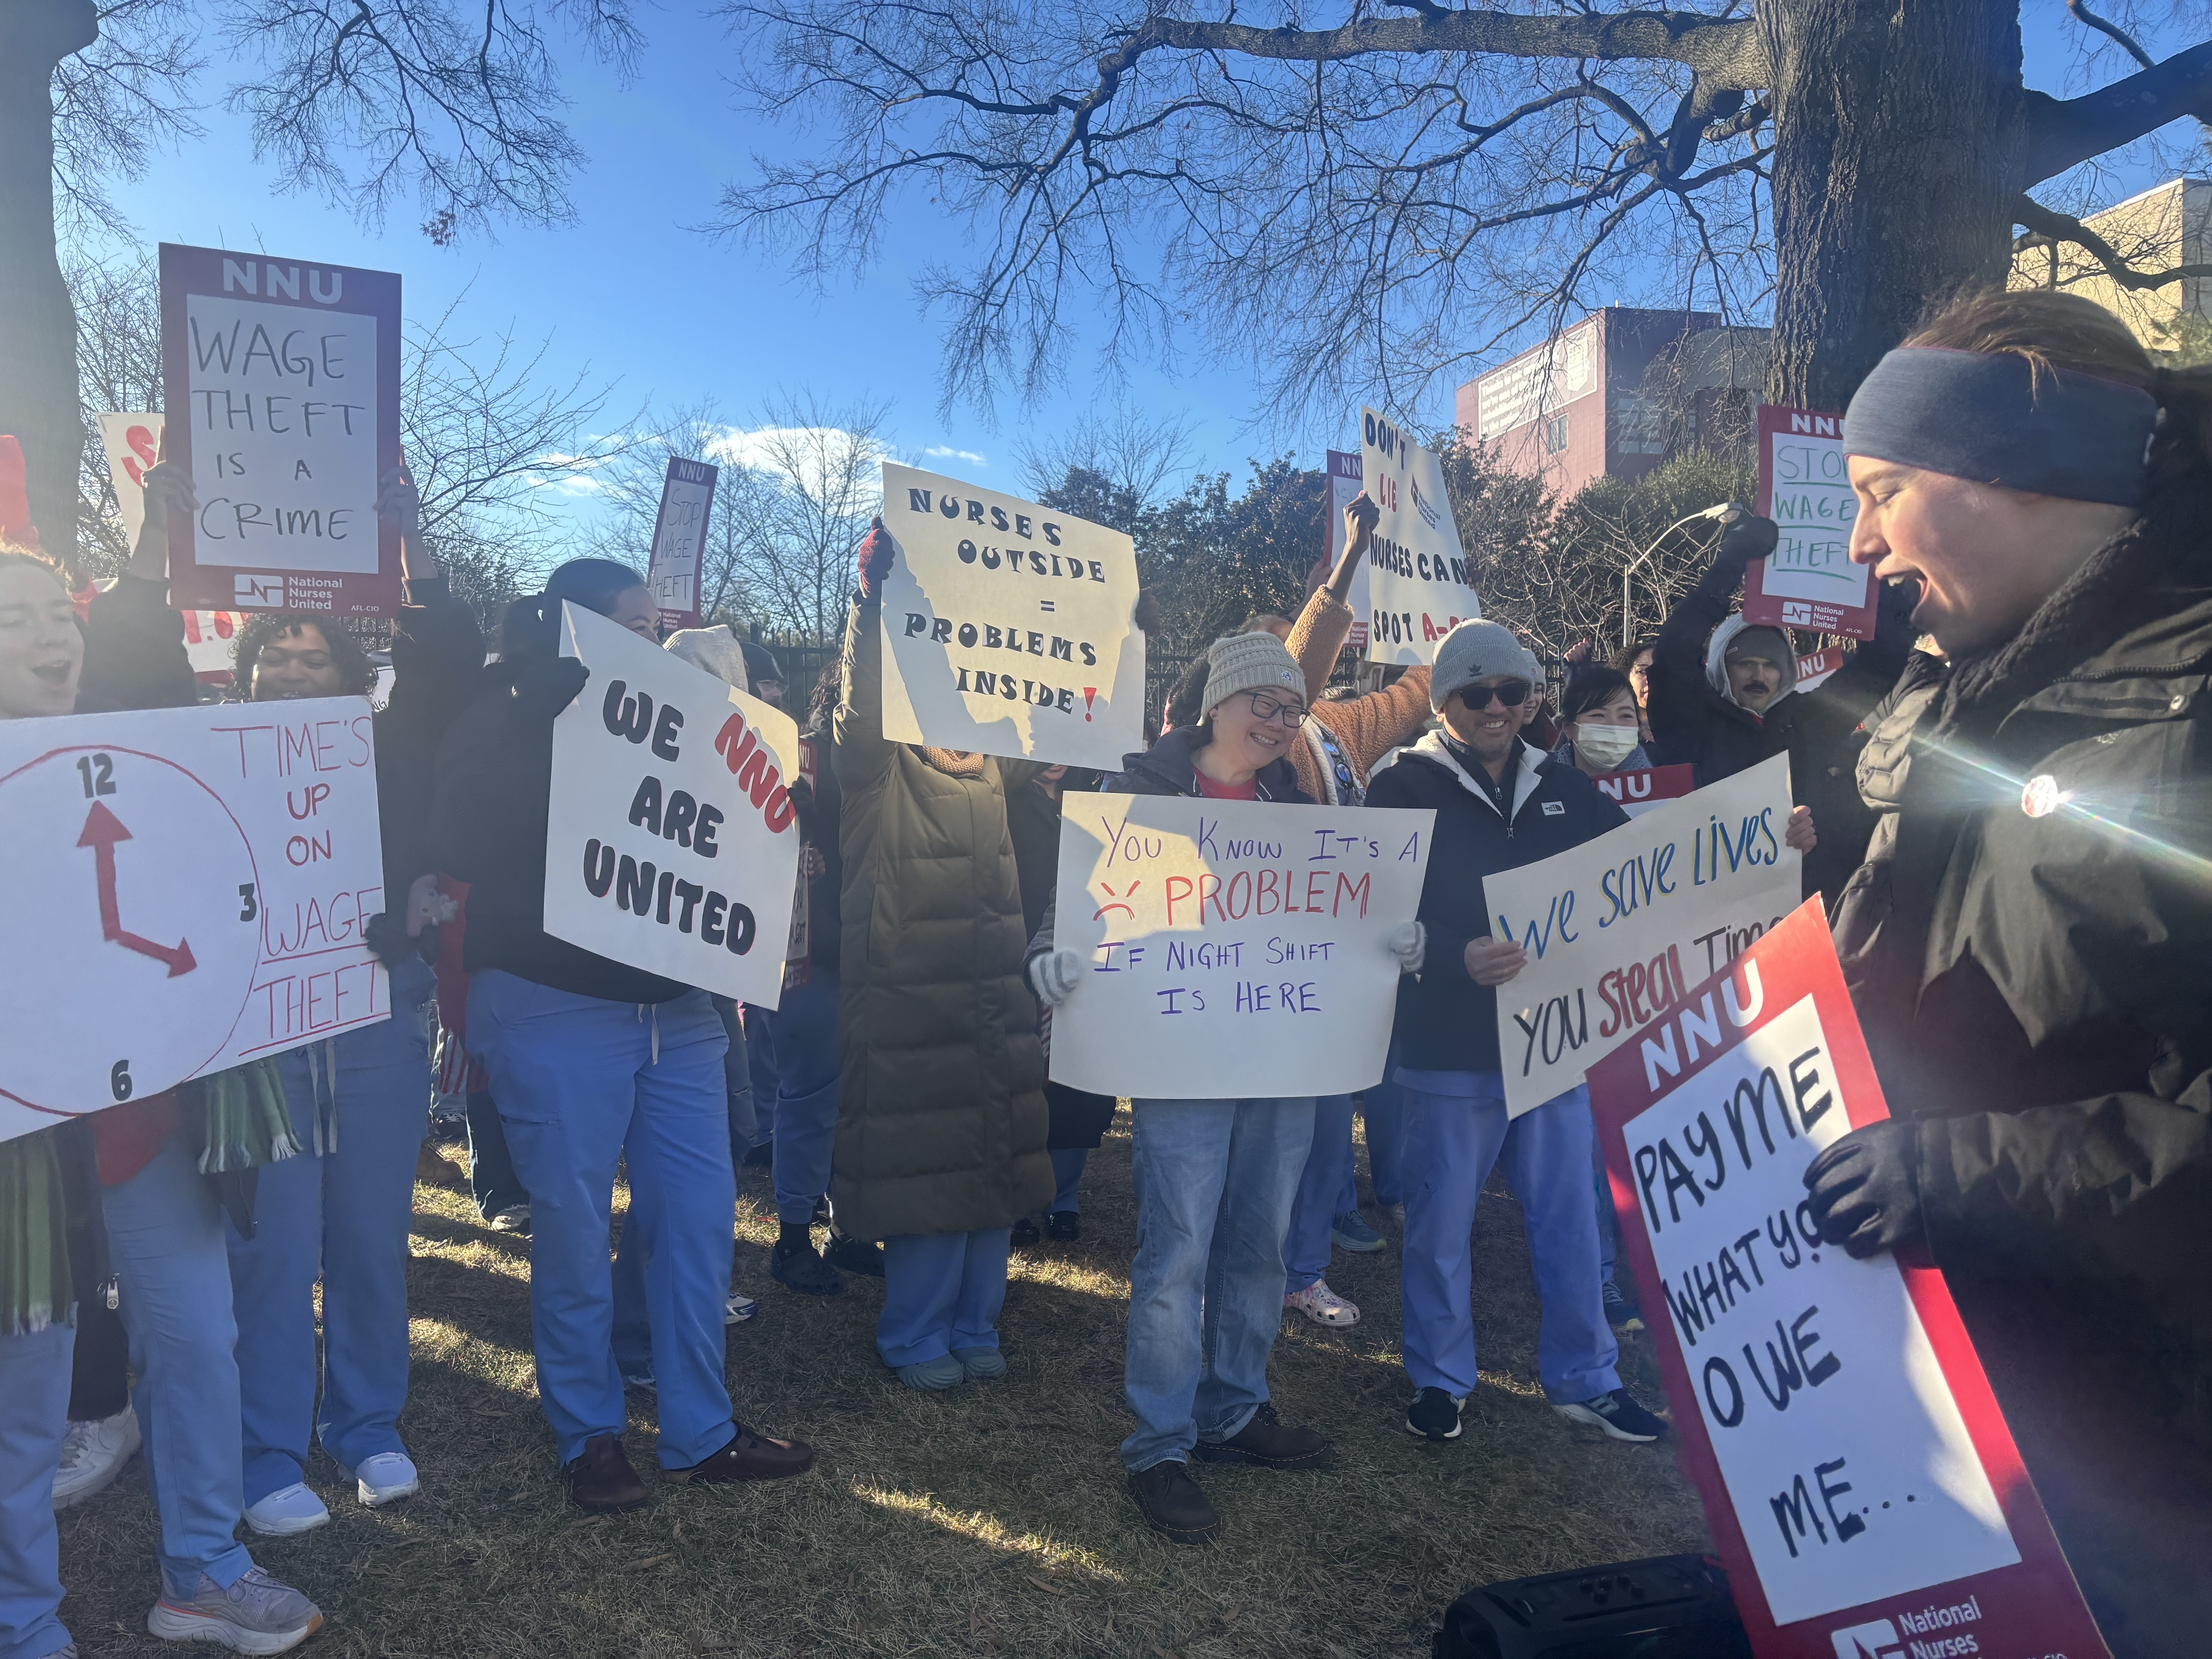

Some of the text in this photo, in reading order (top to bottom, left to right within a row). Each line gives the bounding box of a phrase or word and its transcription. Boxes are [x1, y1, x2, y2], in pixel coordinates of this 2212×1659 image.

[222, 258, 343, 304] NNU
[189, 316, 347, 387] WAGE
[192, 390, 365, 436] THEFT
[1365, 413, 1405, 471] DON'T
[216, 452, 312, 481] IS A
[678, 462, 705, 482] NNU
[1342, 456, 1361, 477] NN
[666, 489, 701, 528] STOP
[1380, 473, 1396, 512] LIE
[1775, 492, 1855, 521] WAGE
[200, 498, 354, 540] CRIME
[907, 488, 1062, 546] NURSES
[661, 531, 692, 559] WAGE
[958, 539, 1106, 583] OUTSIDE
[1370, 533, 1468, 585] NURSES CAN
[289, 577, 342, 588] National
[289, 588, 333, 599] Nurses
[289, 599, 332, 610] United
[1813, 613, 1838, 622] Nurses
[1814, 605, 1844, 616] National
[904, 613, 1096, 666] PROBLEMS
[1374, 609, 1413, 644] SPOT
[1813, 620, 1836, 630] United
[1796, 654, 1825, 679] NU
[955, 666, 1097, 723] INSIDE!
[211, 716, 372, 778] TIME'S
[602, 680, 795, 833] WE NNU
[799, 744, 810, 769] NU
[77, 752, 117, 799] 12
[1599, 774, 1651, 800] NU
[287, 783, 330, 820] UP
[629, 776, 724, 858] ARE
[286, 830, 331, 866] ON
[1101, 816, 1162, 868] YOU
[1197, 816, 1282, 861] KNOW
[1398, 831, 1418, 862] A
[239, 883, 258, 922] 3
[584, 838, 756, 955] UNITED
[1166, 869, 1370, 926] PROBLEM
[265, 887, 382, 956] WAGE
[1094, 936, 1336, 972] IF NIGHT SHIFT
[253, 960, 379, 1039] THEFT
[1157, 981, 1322, 1015] IS HERE
[1640, 957, 1764, 1092] NNU
[111, 1059, 133, 1102] 6
[1662, 1199, 1822, 1347] WHAT YO
[1702, 1305, 1842, 1428] OWE
[1898, 1595, 1983, 1635] National
[1909, 1633, 1980, 1659] Nurses
